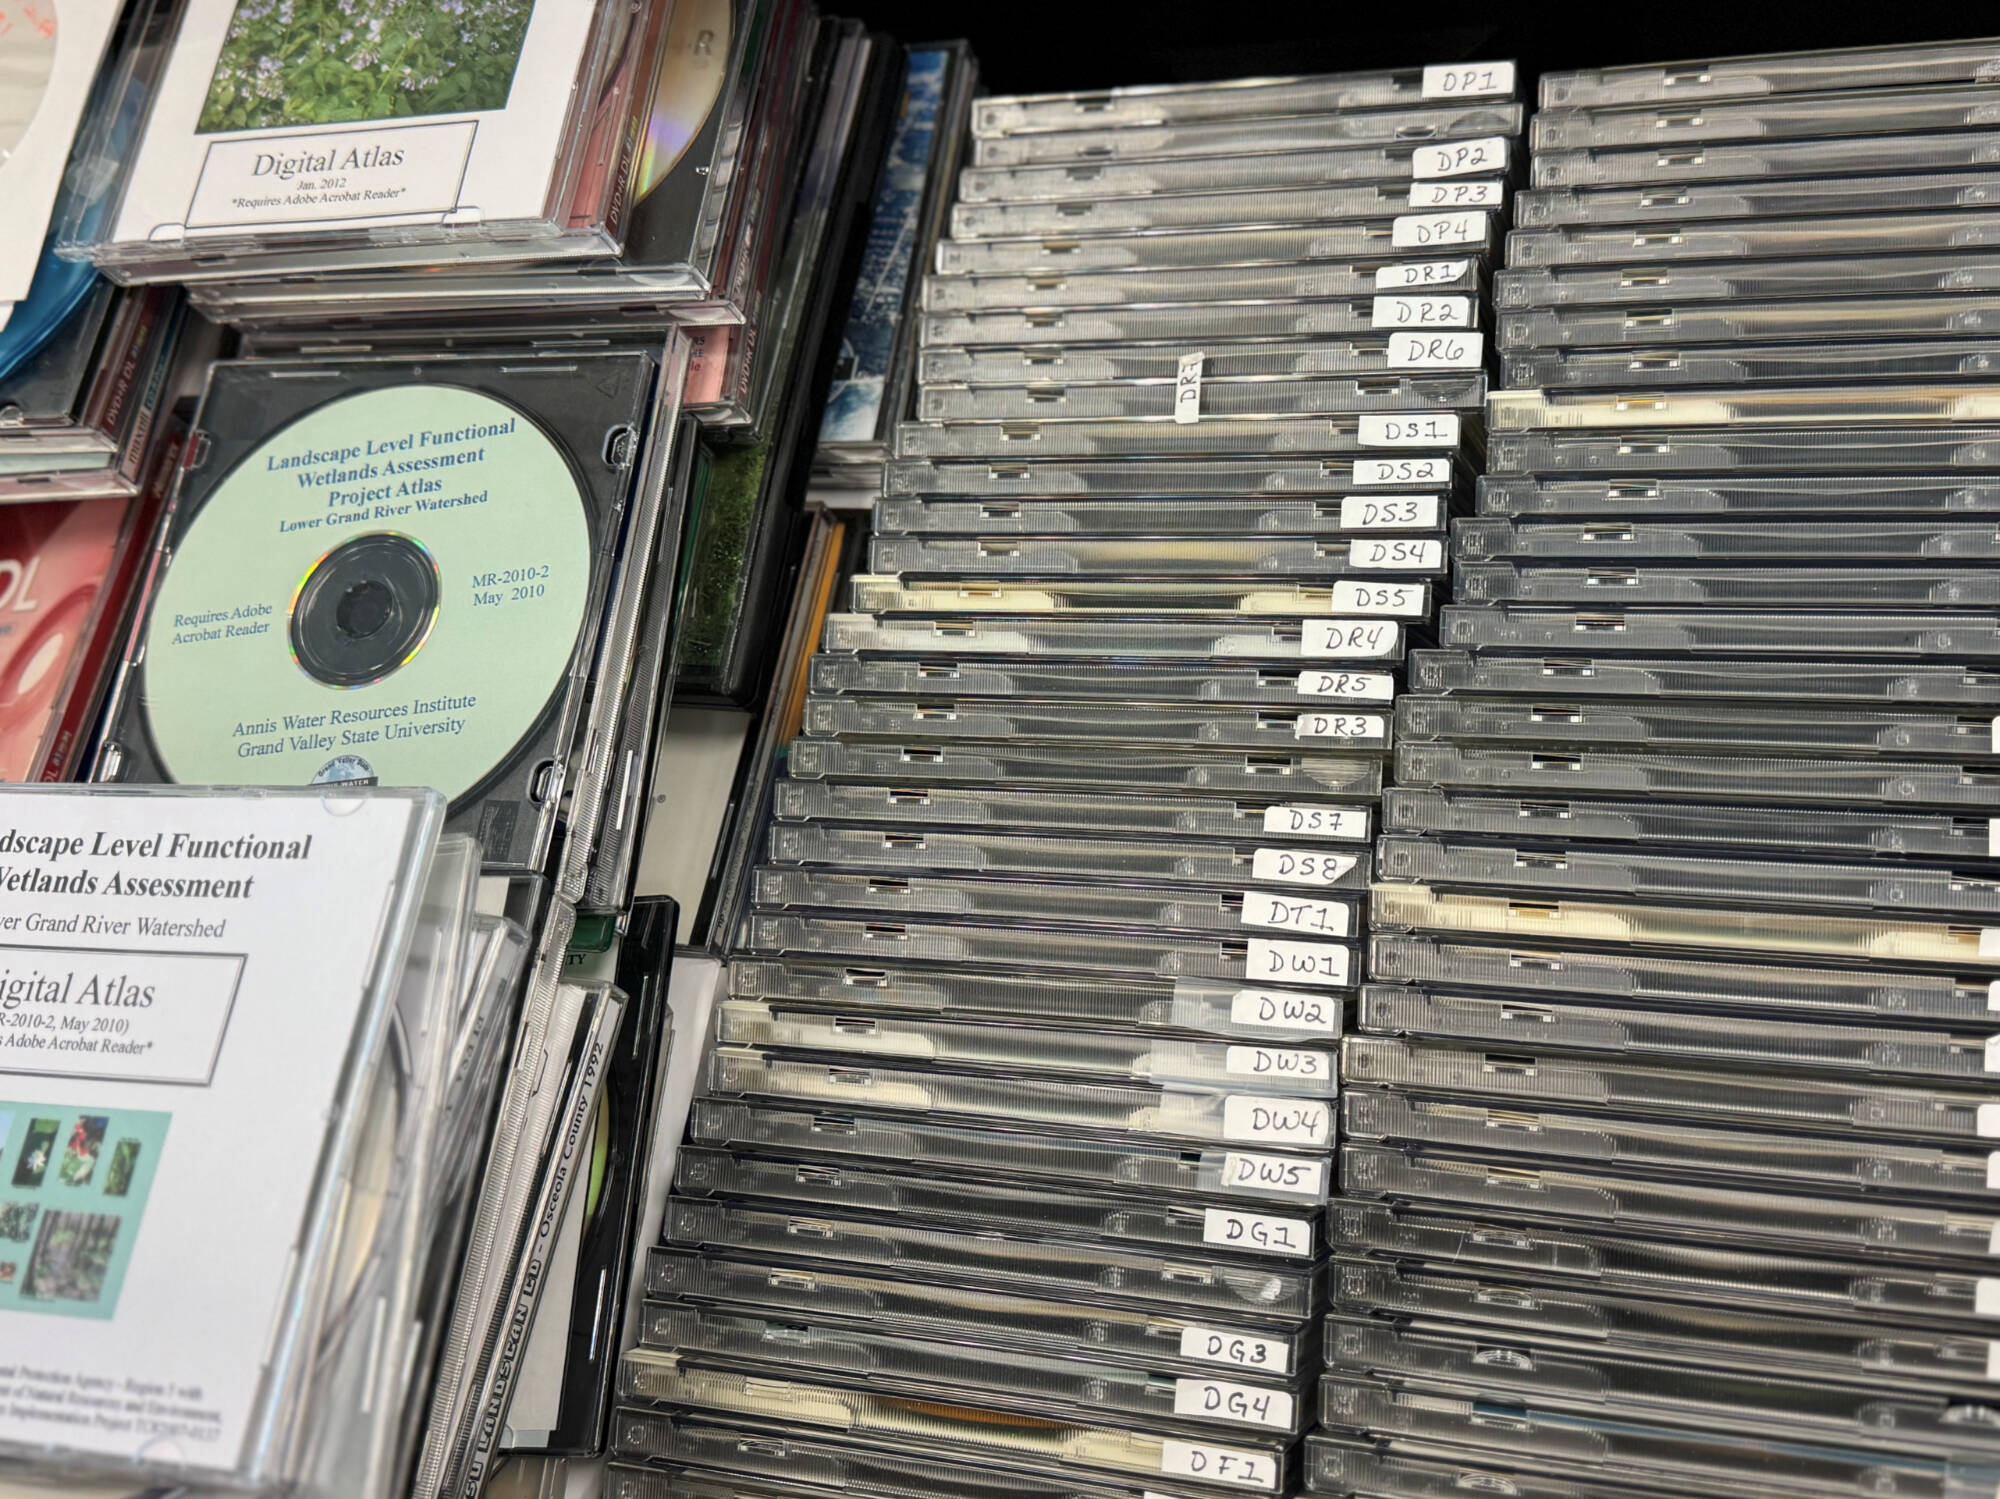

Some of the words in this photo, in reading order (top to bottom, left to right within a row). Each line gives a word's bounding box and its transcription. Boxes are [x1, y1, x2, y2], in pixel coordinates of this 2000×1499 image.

[1443, 71, 1496, 92] DP1
[252, 149, 337, 180] Digital
[340, 145, 405, 170] Atlas
[1437, 147, 1487, 172] DP2
[297, 180, 316, 191] Jan.
[320, 177, 347, 189] 2012
[1431, 186, 1488, 203] DP3
[283, 193, 319, 205] Adobe
[319, 190, 360, 203] Acrobat
[1416, 219, 1468, 243] DP4
[1404, 264, 1457, 283] DR1
[1396, 300, 1458, 323] DR2
[1407, 339, 1464, 361] DR6
[1385, 421, 1448, 440] DS1
[267, 446, 361, 471] Landscape
[366, 434, 413, 456] Level
[419, 418, 516, 447] Functional
[298, 463, 378, 488] Wetlands
[382, 447, 485, 476] Assessment
[1376, 462, 1434, 480] DS2
[328, 485, 392, 507] Project
[396, 477, 443, 497] Atlas
[280, 518, 322, 532] Lower
[325, 508, 370, 525] Grand
[374, 504, 412, 518] River
[415, 490, 488, 512] Watershed
[1362, 502, 1418, 525] DS3
[1369, 542, 1426, 564] DS4
[472, 565, 549, 588] MR-2010-2
[473, 592, 503, 606] May
[511, 584, 545, 600] 2010
[1355, 588, 1414, 607] DS5
[173, 609, 228, 628] Requires
[230, 603, 273, 620] Adobe
[171, 628, 222, 645] Acrobat
[225, 621, 270, 638] Reader
[1325, 626, 1384, 650] DR4
[1317, 674, 1372, 694] DR5
[232, 718, 277, 737] Annis
[283, 713, 326, 731] Water
[330, 704, 408, 725] Resources
[413, 695, 477, 715] Institute
[1314, 716, 1367, 736] DR3
[238, 738, 284, 758] Grand
[289, 733, 337, 751] Valley
[341, 728, 380, 745] State
[385, 716, 466, 740] University
[1289, 809, 1343, 831] DS7
[89, 831, 163, 857] Level
[166, 833, 313, 860] Functional
[1278, 854, 1338, 880] DS8
[102, 870, 255, 899] Assessment
[25, 912, 80, 933] Grand
[81, 914, 131, 935] River
[137, 917, 226, 938] Watershed
[1267, 901, 1334, 931] DT1
[1268, 950, 1340, 977] DW1
[74, 973, 156, 1008] Atlas
[1258, 996, 1327, 1024] DW2
[60, 1015, 89, 1034] May
[91, 1017, 130, 1036] 2010)
[5, 1033, 46, 1049] Adobe
[47, 1035, 98, 1052] Acrobat
[1253, 1050, 1317, 1075] DW3
[1252, 1107, 1320, 1137] DW4
[1238, 1157, 1311, 1185] DW5
[1226, 1218, 1296, 1248] DG1
[478, 1303, 529, 1453] LANDSCAN
[523, 1259, 542, 1297] CD
[540, 1168, 567, 1237] Osceola
[563, 1097, 588, 1160] County
[584, 1042, 604, 1087] 1992
[1207, 1335, 1267, 1363] DG3
[1204, 1385, 1271, 1420] DG4
[1191, 1450, 1264, 1483] DF1
